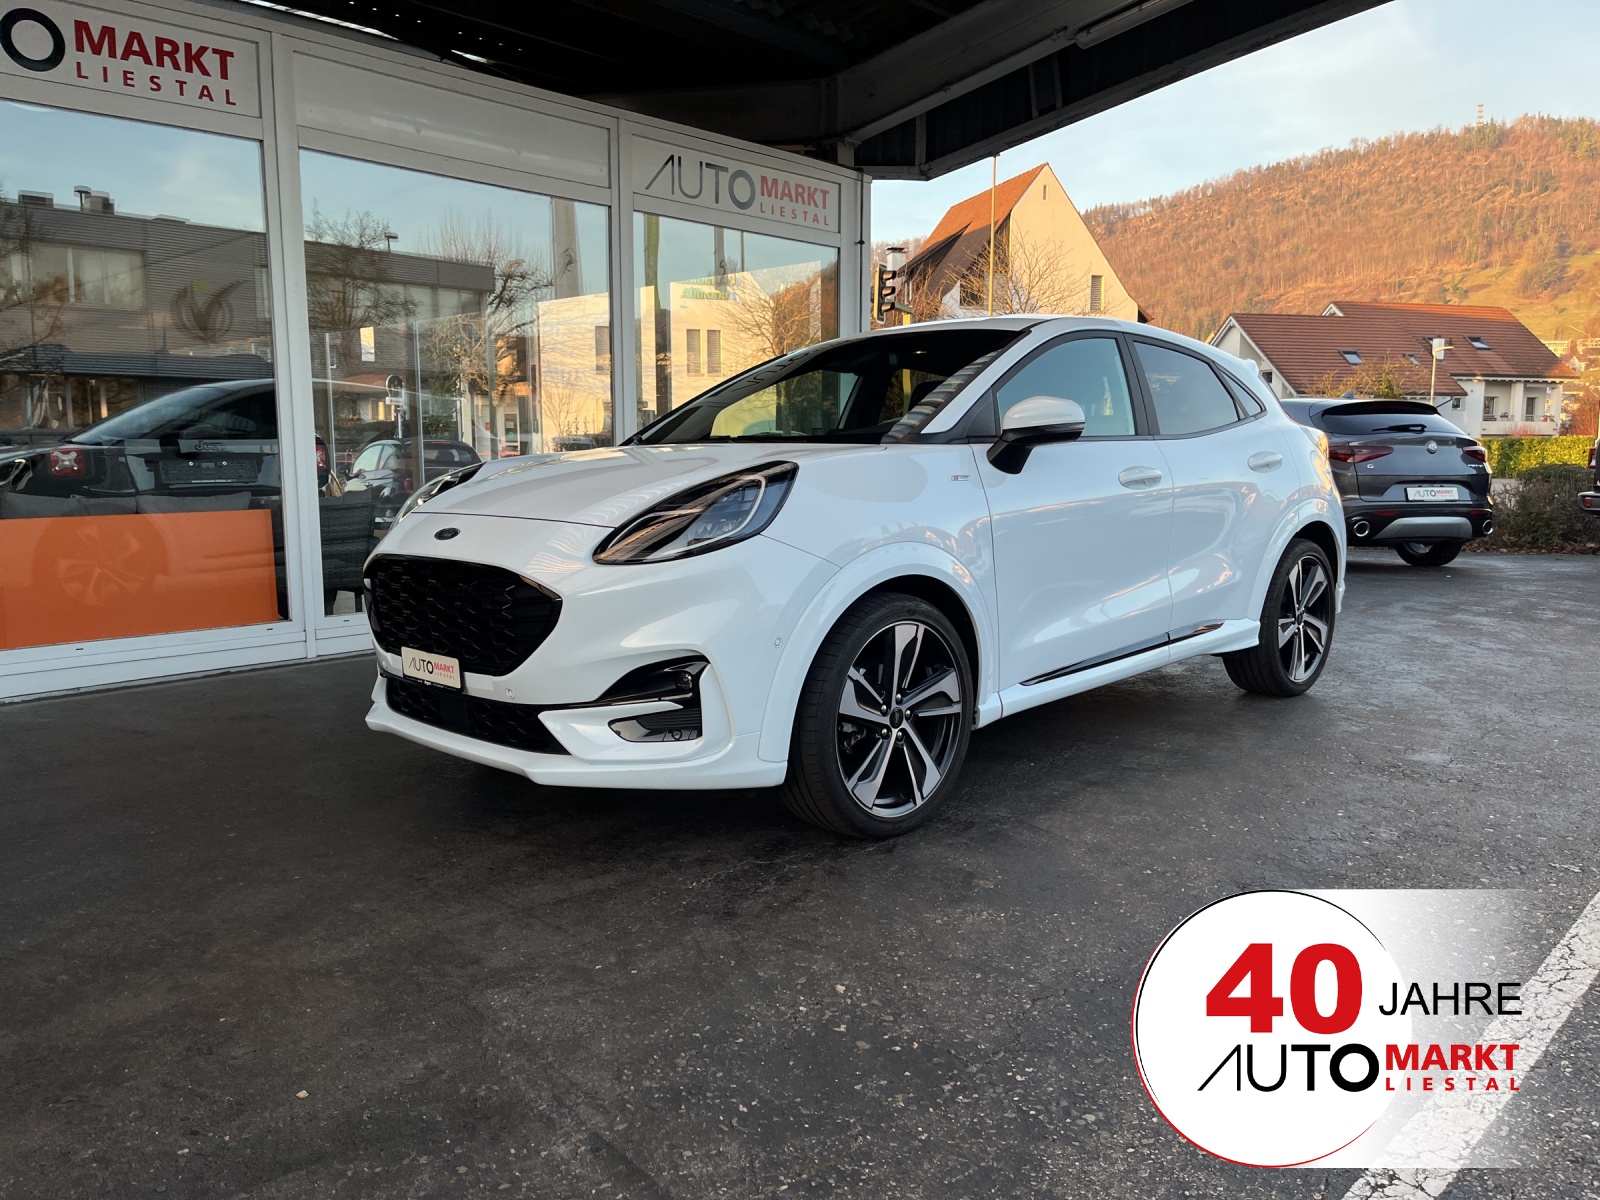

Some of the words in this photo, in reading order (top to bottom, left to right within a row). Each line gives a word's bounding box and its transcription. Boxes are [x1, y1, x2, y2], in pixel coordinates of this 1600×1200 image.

[73, 19, 235, 81] MARKT
[75, 61, 237, 106] LIESTAL
[644, 154, 756, 211] AUTO
[760, 175, 830, 210] MARKT
[759, 201, 830, 226] LIESTAL
[194, 440, 225, 451] Jeep
[408, 657, 434, 674] AUTO
[434, 662, 454, 674] MARKT
